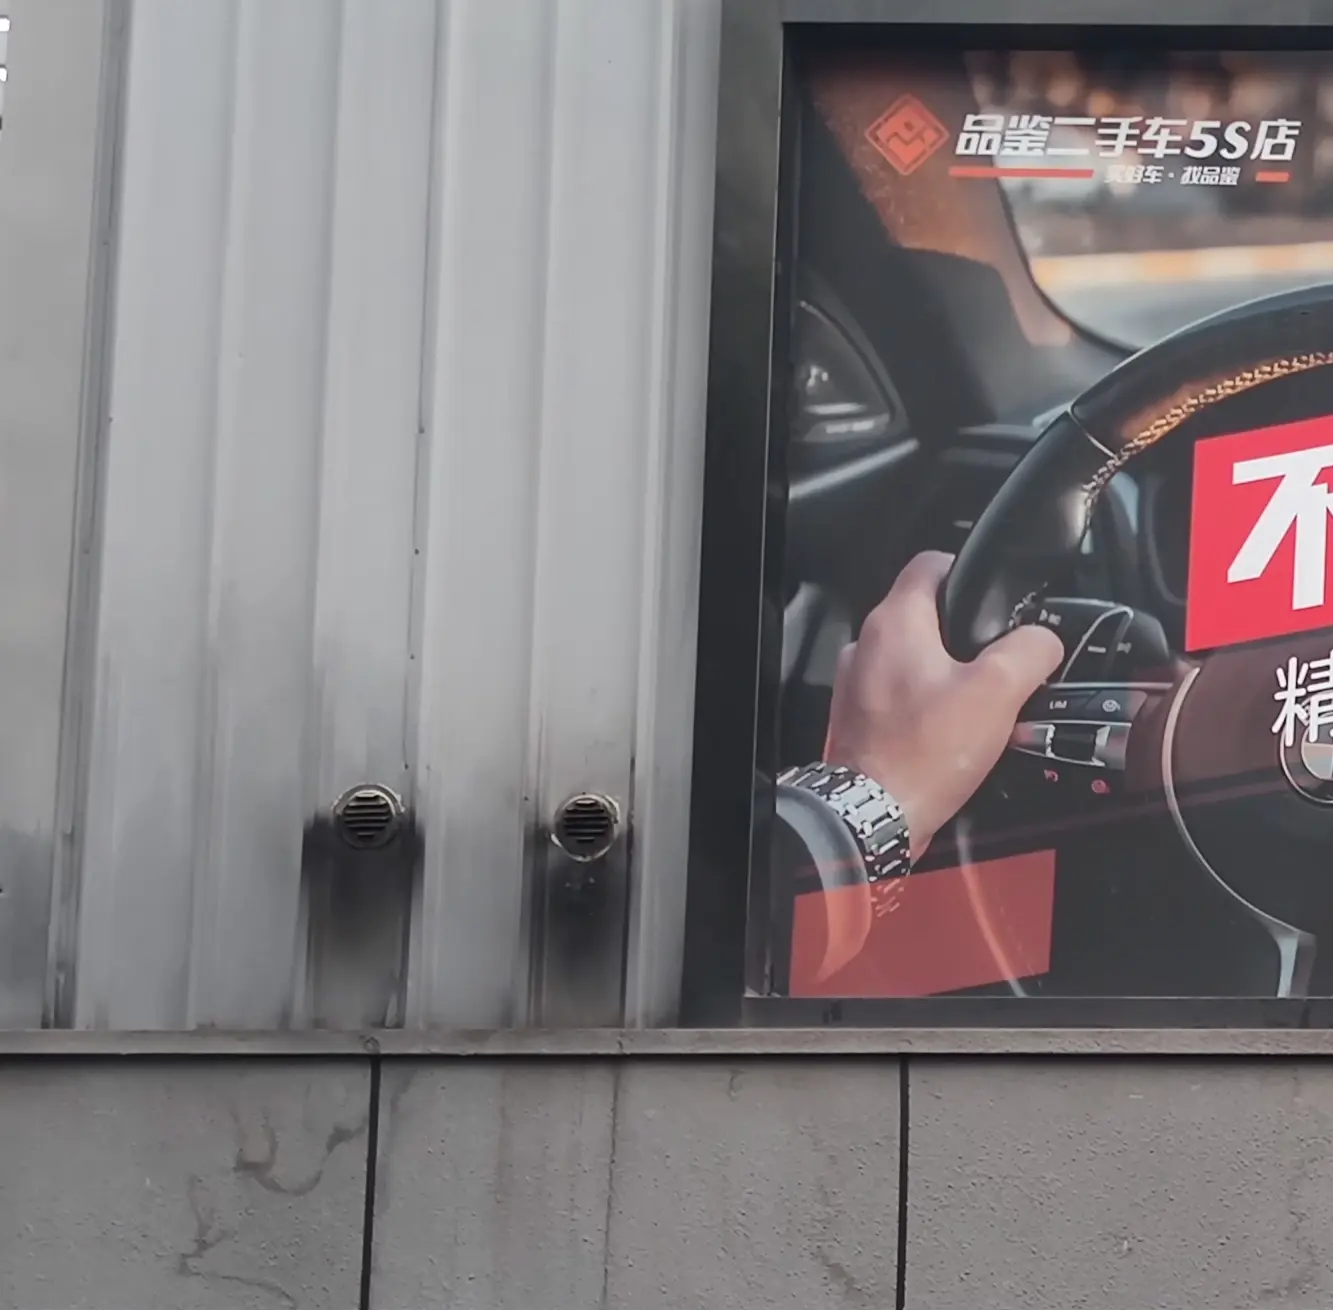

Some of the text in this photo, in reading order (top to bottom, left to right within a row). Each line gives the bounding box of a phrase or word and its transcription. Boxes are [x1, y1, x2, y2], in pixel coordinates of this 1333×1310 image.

[955, 113, 1302, 161] 品鉴二手车5S店
